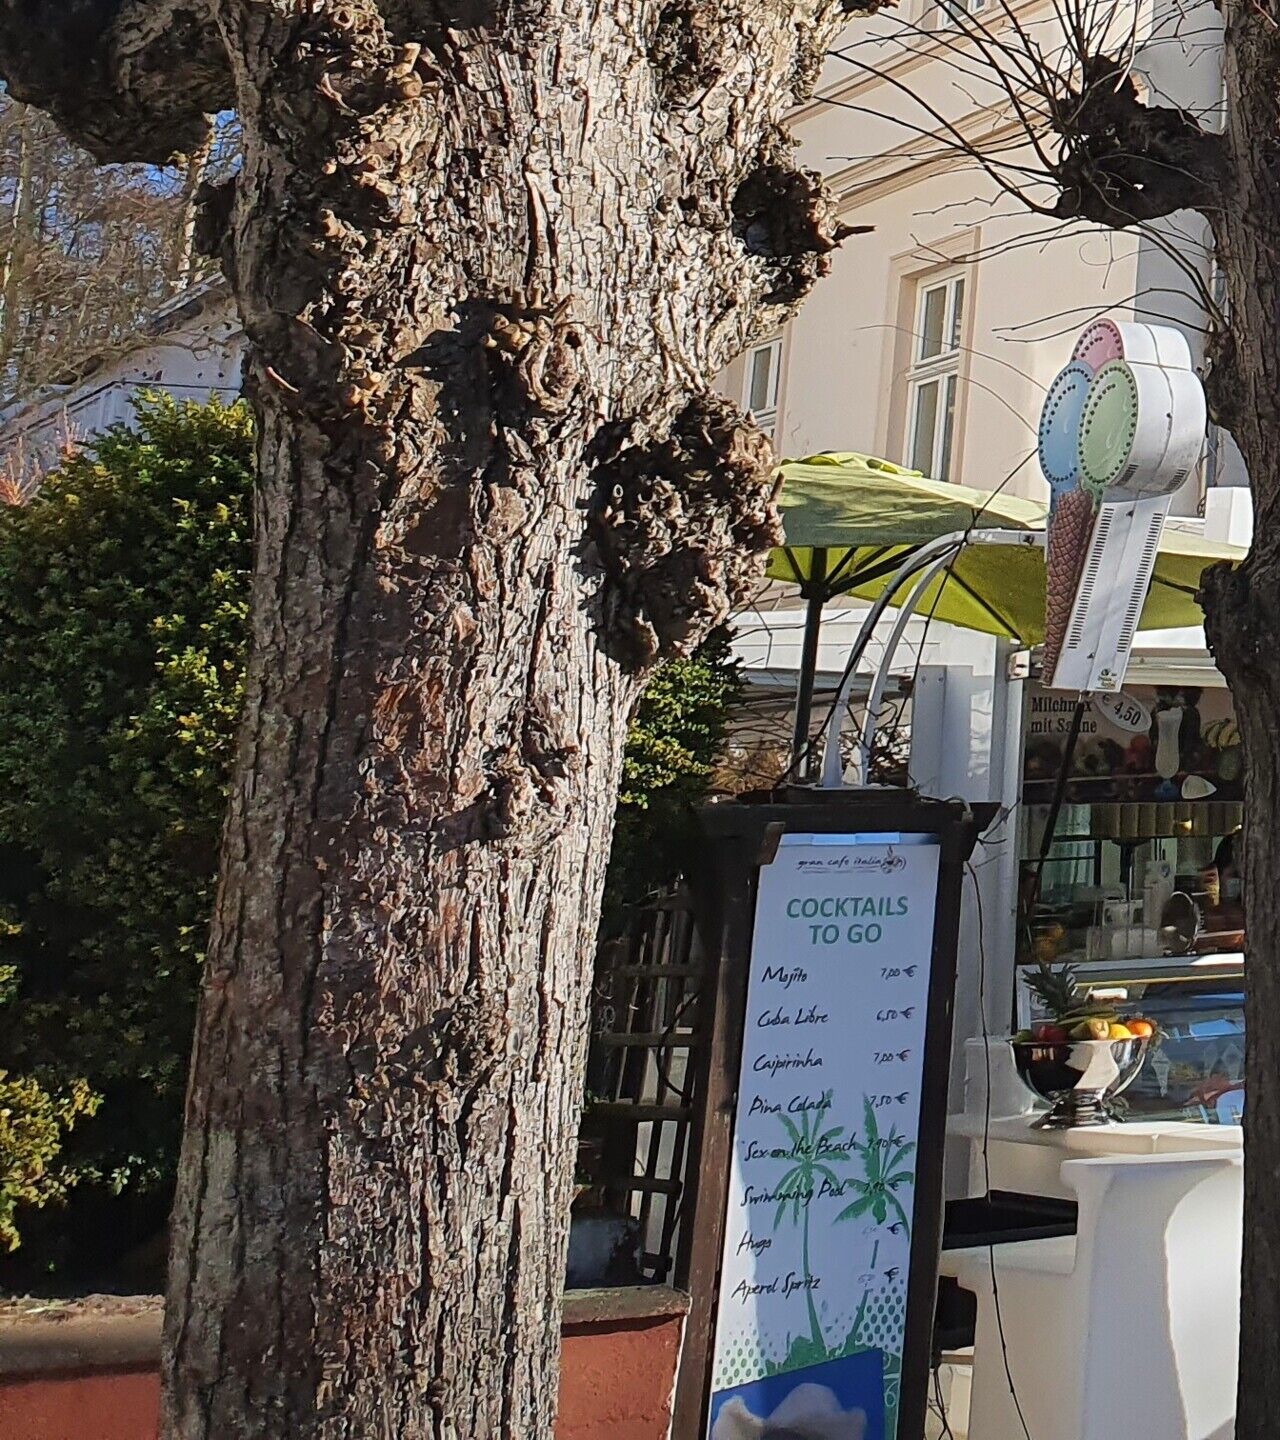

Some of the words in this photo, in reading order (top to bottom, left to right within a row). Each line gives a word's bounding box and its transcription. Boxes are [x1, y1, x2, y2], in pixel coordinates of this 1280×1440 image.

[1031, 696, 1092, 713] Milchmx
[1113, 701, 1142, 727] 4,50
[1031, 719, 1053, 734] mit
[1056, 718, 1097, 734] Sane
[786, 896, 909, 919] COCKTAILS
[809, 925, 840, 945] TO
[847, 923, 882, 944] GO
[761, 965, 808, 990] Mojito
[757, 1006, 790, 1028] Cuba
[794, 1005, 829, 1026] Libre
[753, 1048, 823, 1078] Caipirinha
[744, 1140, 768, 1162] Sex
[815, 1131, 857, 1156] Beach
[818, 1177, 849, 1199] Pool
[781, 1271, 821, 1299] Spritz
